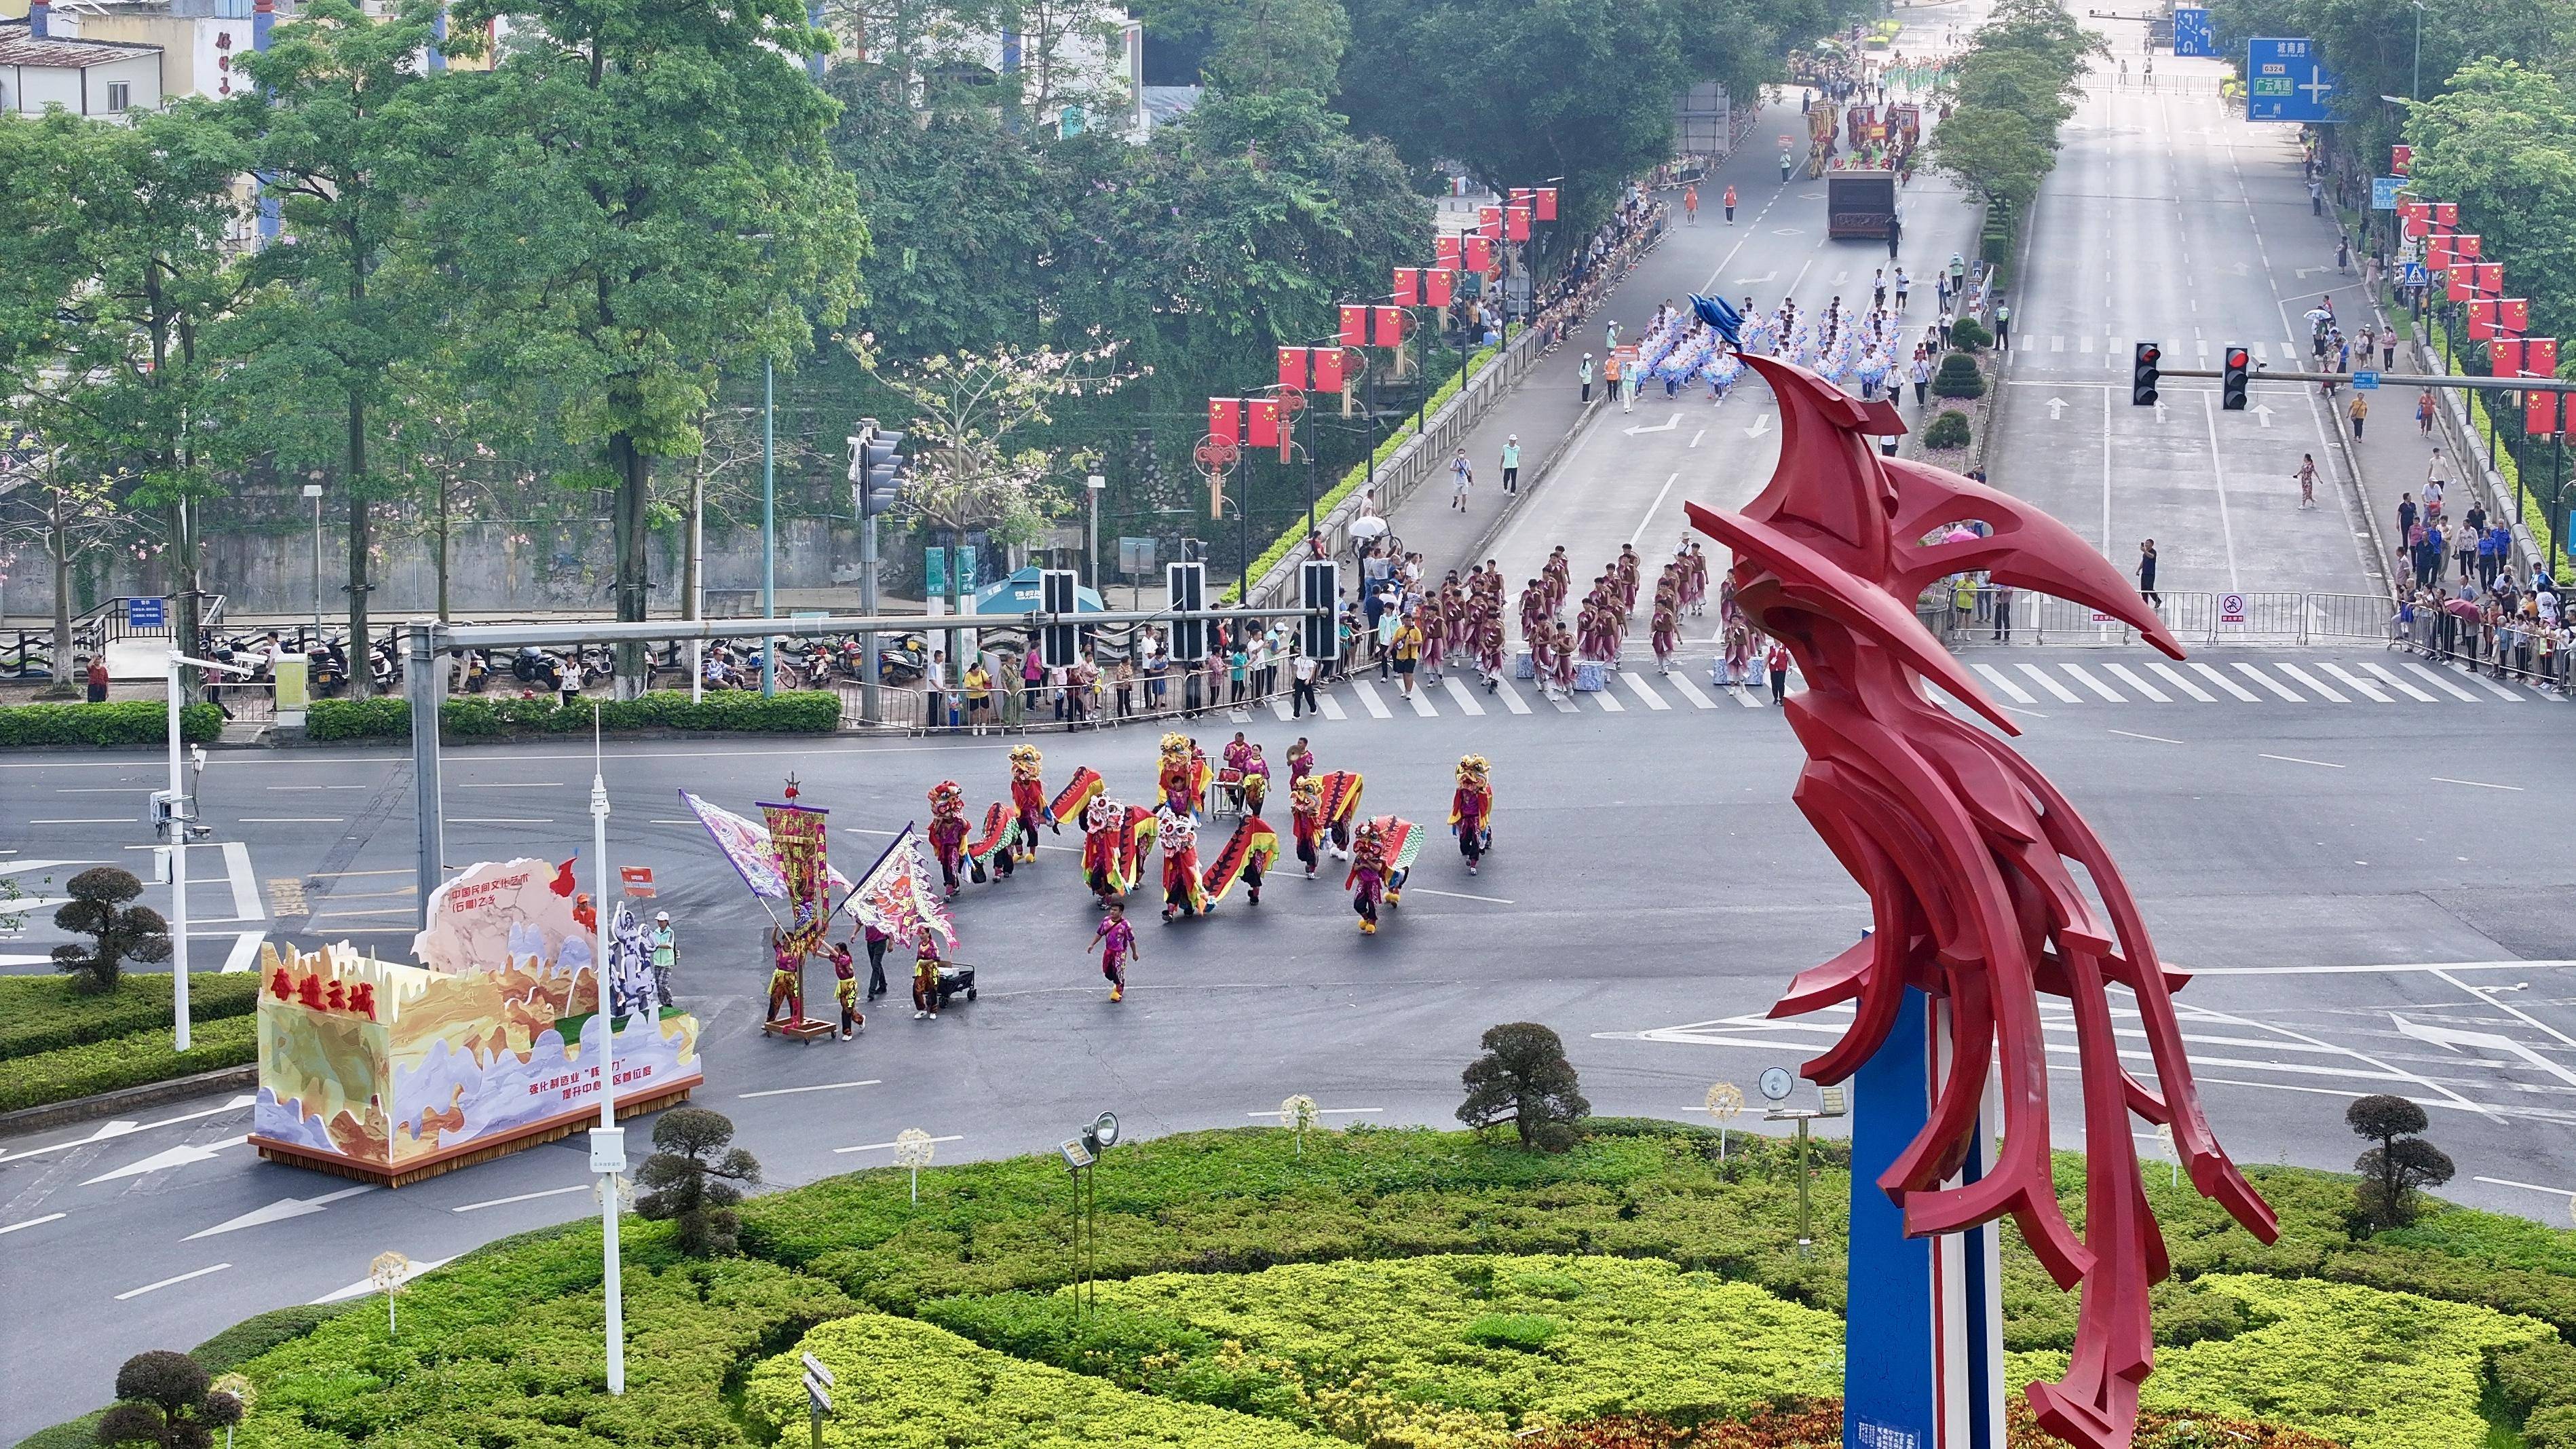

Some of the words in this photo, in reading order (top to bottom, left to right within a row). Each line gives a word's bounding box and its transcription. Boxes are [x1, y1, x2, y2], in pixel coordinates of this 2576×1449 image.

[2277, 42, 2305, 54] 城南路
[2256, 79, 2291, 91] 广云高速
[2253, 103, 2281, 115] 广州
[452, 873, 529, 899] 中国民间文化艺术
[563, 1066, 651, 1100] 提升中心区首位度
